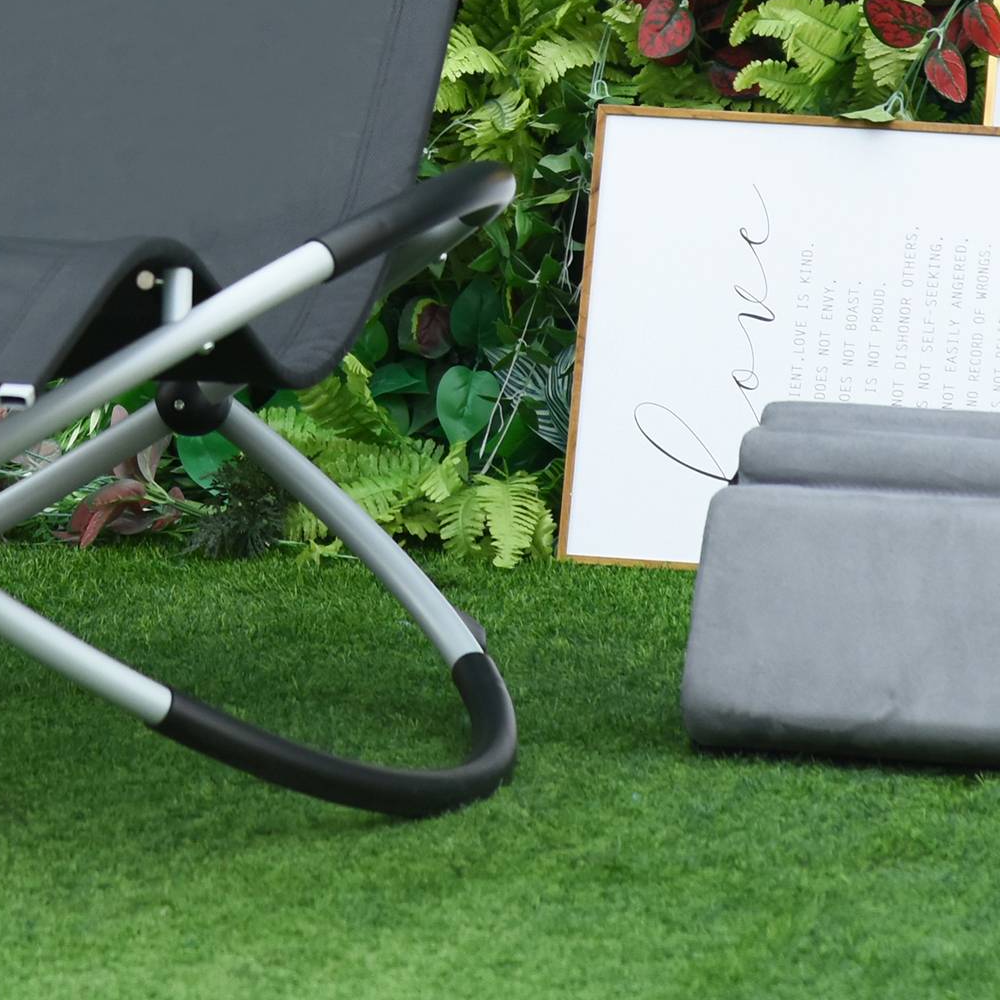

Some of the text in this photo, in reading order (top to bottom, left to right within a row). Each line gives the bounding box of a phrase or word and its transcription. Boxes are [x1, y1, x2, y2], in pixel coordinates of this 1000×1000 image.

[796, 293, 810, 309] IS
[972, 308, 985, 325] OF
[817, 330, 831, 357] NOT
[894, 297, 912, 370] DISHONOR
[944, 319, 961, 373] EASILY
[841, 341, 856, 367] NOT
[866, 342, 881, 368] NOT
[967, 332, 984, 382] RECORD
[813, 365, 829, 400] DOES
[838, 376, 853, 402] OES
[864, 377, 878, 393] IS
[917, 363, 932, 390] NOT
[965, 391, 979, 407] NO
